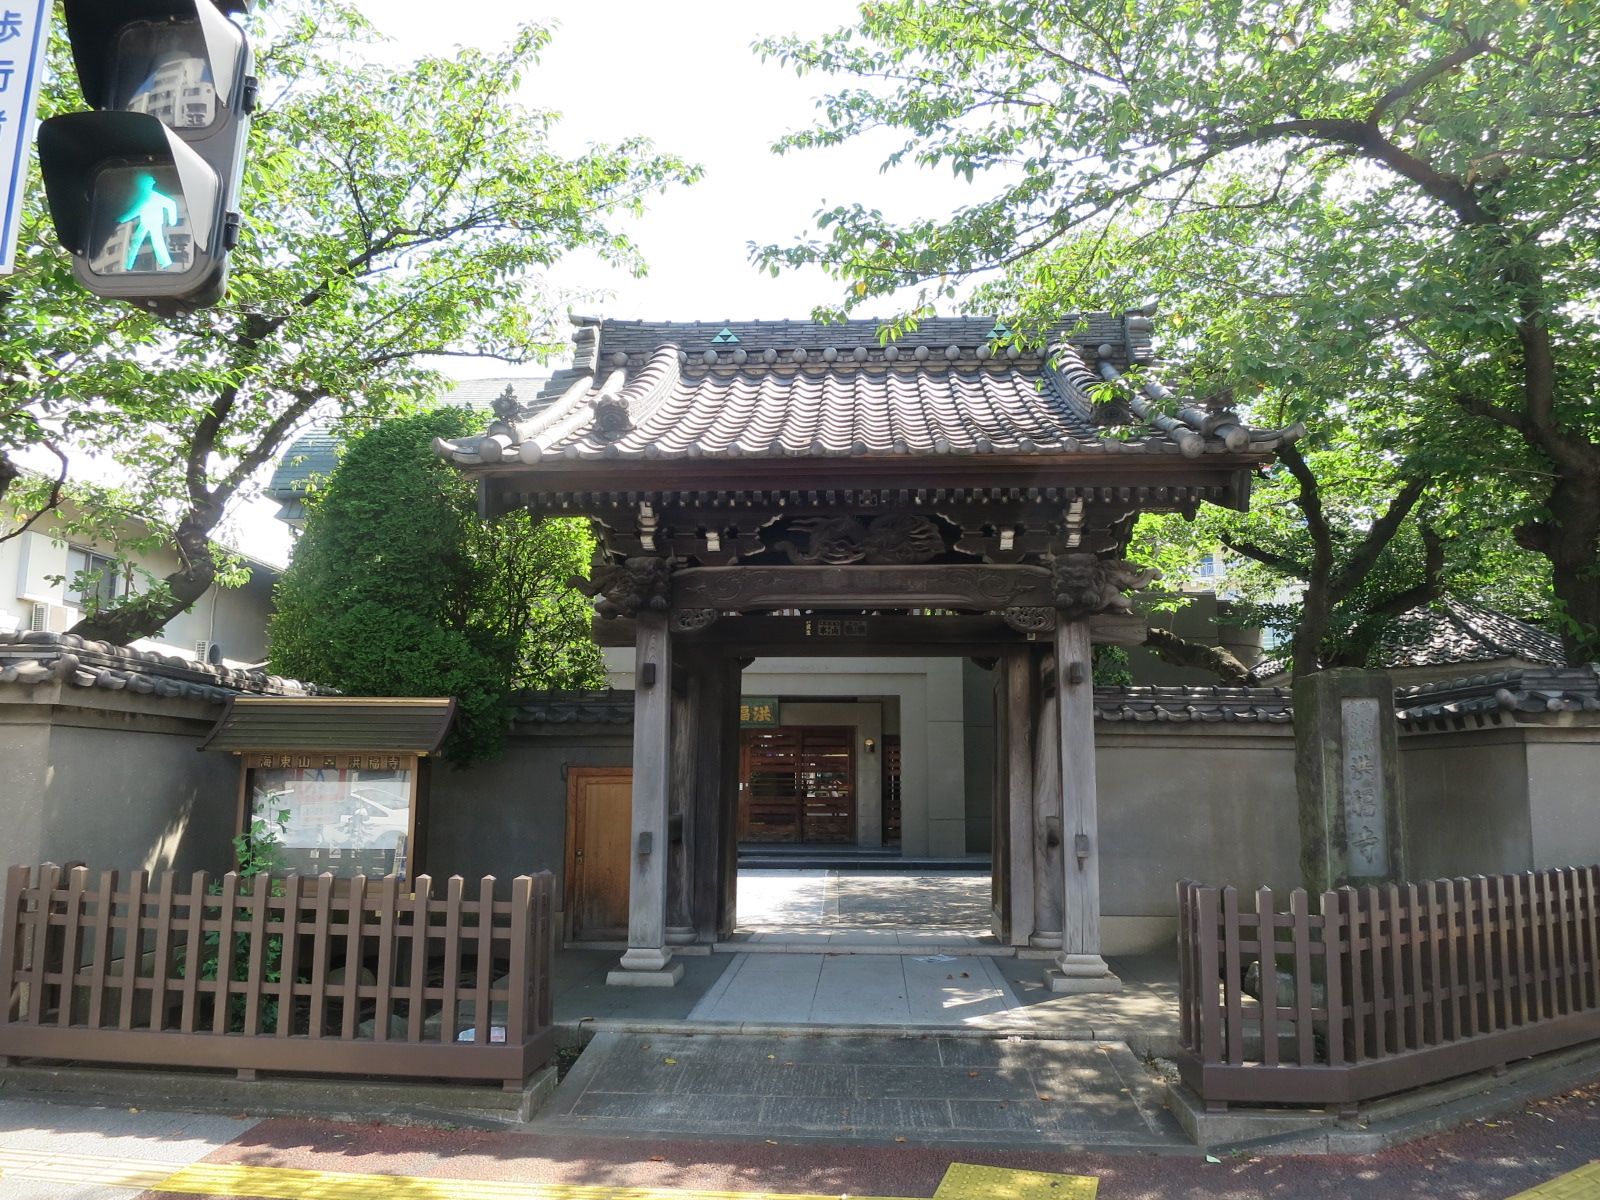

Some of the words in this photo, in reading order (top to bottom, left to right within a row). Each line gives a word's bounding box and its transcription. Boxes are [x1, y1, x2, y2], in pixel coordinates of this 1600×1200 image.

[259, 755, 311, 768] 海東山
[349, 755, 400, 769] 洪福寺
